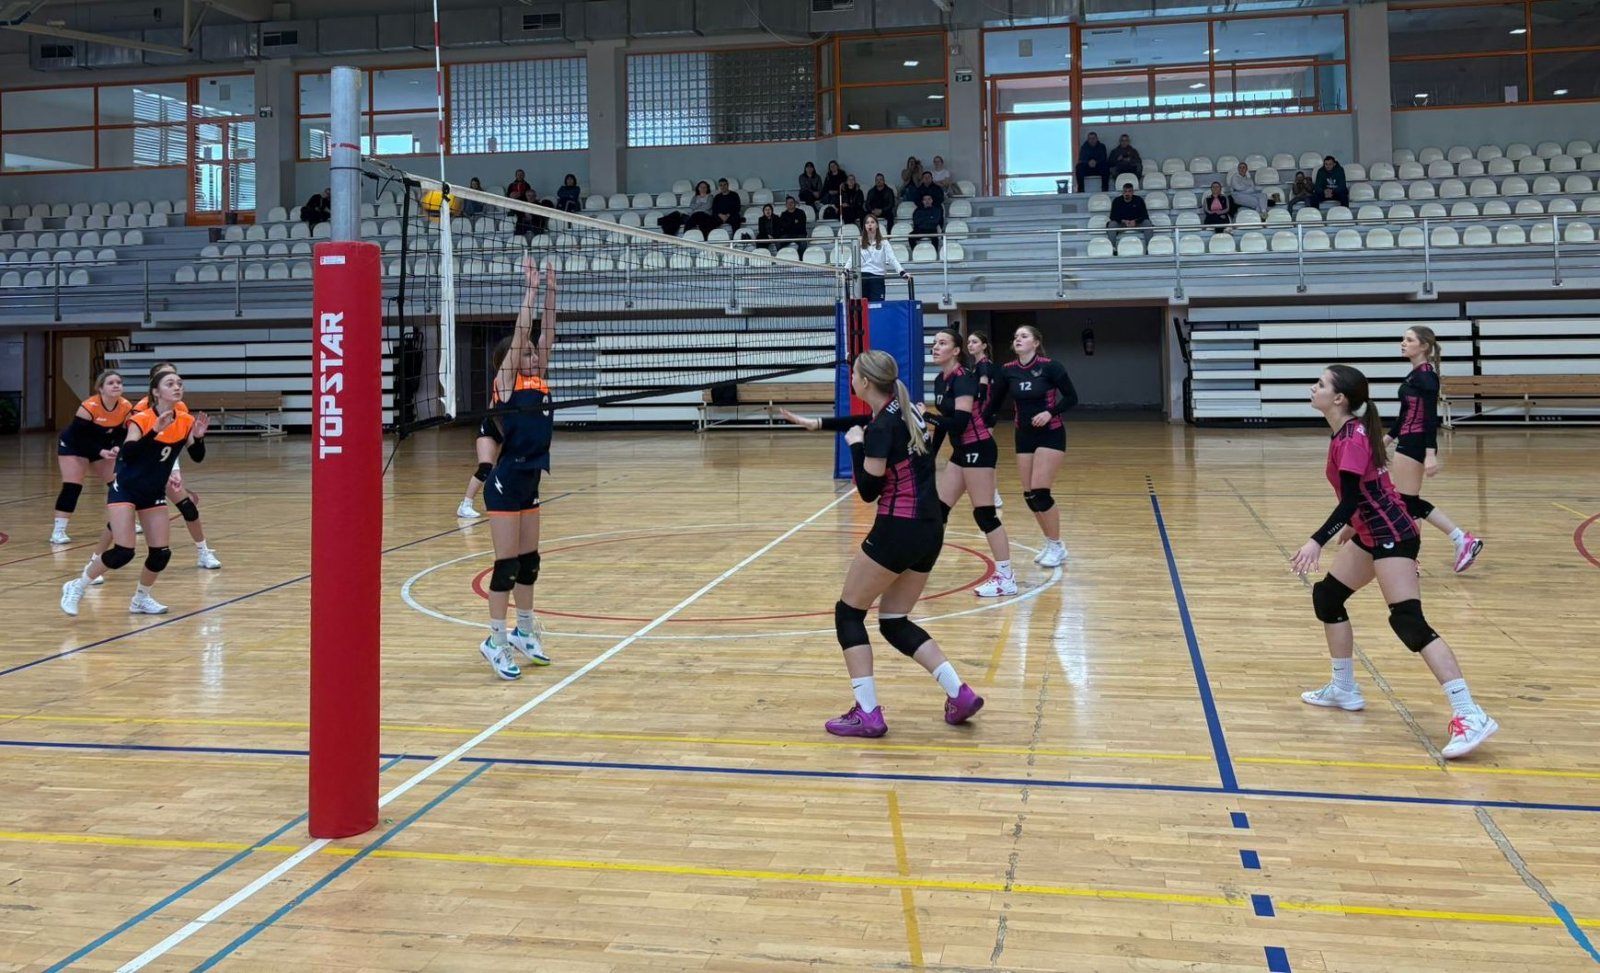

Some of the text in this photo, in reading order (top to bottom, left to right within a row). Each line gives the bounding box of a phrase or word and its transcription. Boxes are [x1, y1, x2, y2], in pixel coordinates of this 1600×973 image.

[319, 311, 344, 460] TOPSTAR
[1018, 381, 1032, 391] 12
[160, 446, 172, 462] 9
[965, 452, 979, 464] 17
